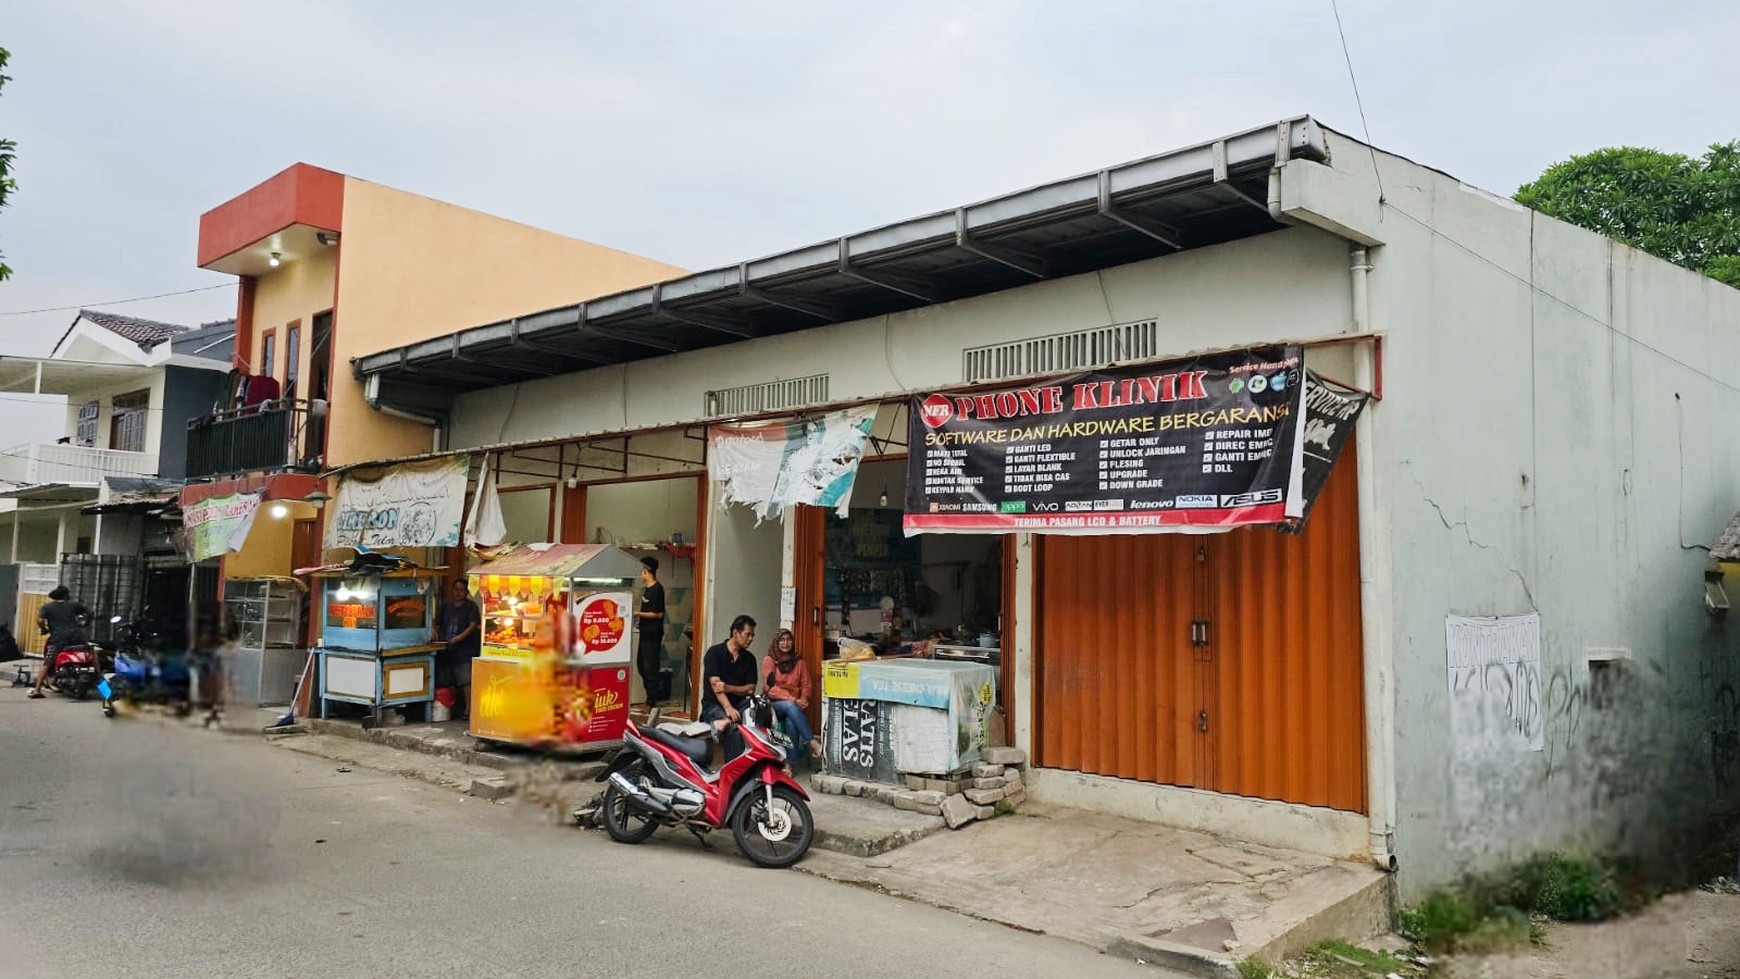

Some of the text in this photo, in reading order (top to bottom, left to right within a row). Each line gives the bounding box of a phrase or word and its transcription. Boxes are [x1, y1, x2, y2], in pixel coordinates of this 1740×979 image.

[1229, 362, 1259, 374] Service
[954, 371, 1209, 421] PHONE KLINIK
[1305, 381, 1343, 416] ERVICE
[925, 403, 1290, 446] SOFTWARE DAN HARDWARE BERGARANSI
[1216, 430, 1251, 439] REPAIR
[1110, 437, 1160, 448] GETAR ONLY
[1216, 441, 1246, 450] DIREC
[1015, 445, 1036, 453] GANTI
[1110, 446, 1186, 458] UNLOCK JARINGAN
[1014, 452, 1076, 463] GANTI FLEXTIBLE
[1215, 453, 1245, 462] GANTI
[1014, 463, 1062, 473] LAYAR BLANK
[1109, 459, 1144, 468] FLESING
[1215, 464, 1233, 473] DLL
[1036, 474, 1053, 482] BISA
[1054, 473, 1071, 481] CAS
[1110, 470, 1148, 479] UPGRADE
[1013, 483, 1053, 493] BOOT LOOP
[1109, 479, 1163, 489] DOWN GRADE
[962, 503, 997, 512] SAMSUNG
[1130, 500, 1174, 508] lenovo
[1179, 495, 1214, 503] NOKIA
[1223, 490, 1279, 507] ASUS
[1014, 515, 1161, 527] TERIMA PASANG LCD & BATTERY
[843, 699, 859, 763] ELAS
[860, 699, 876, 768] RATIS
